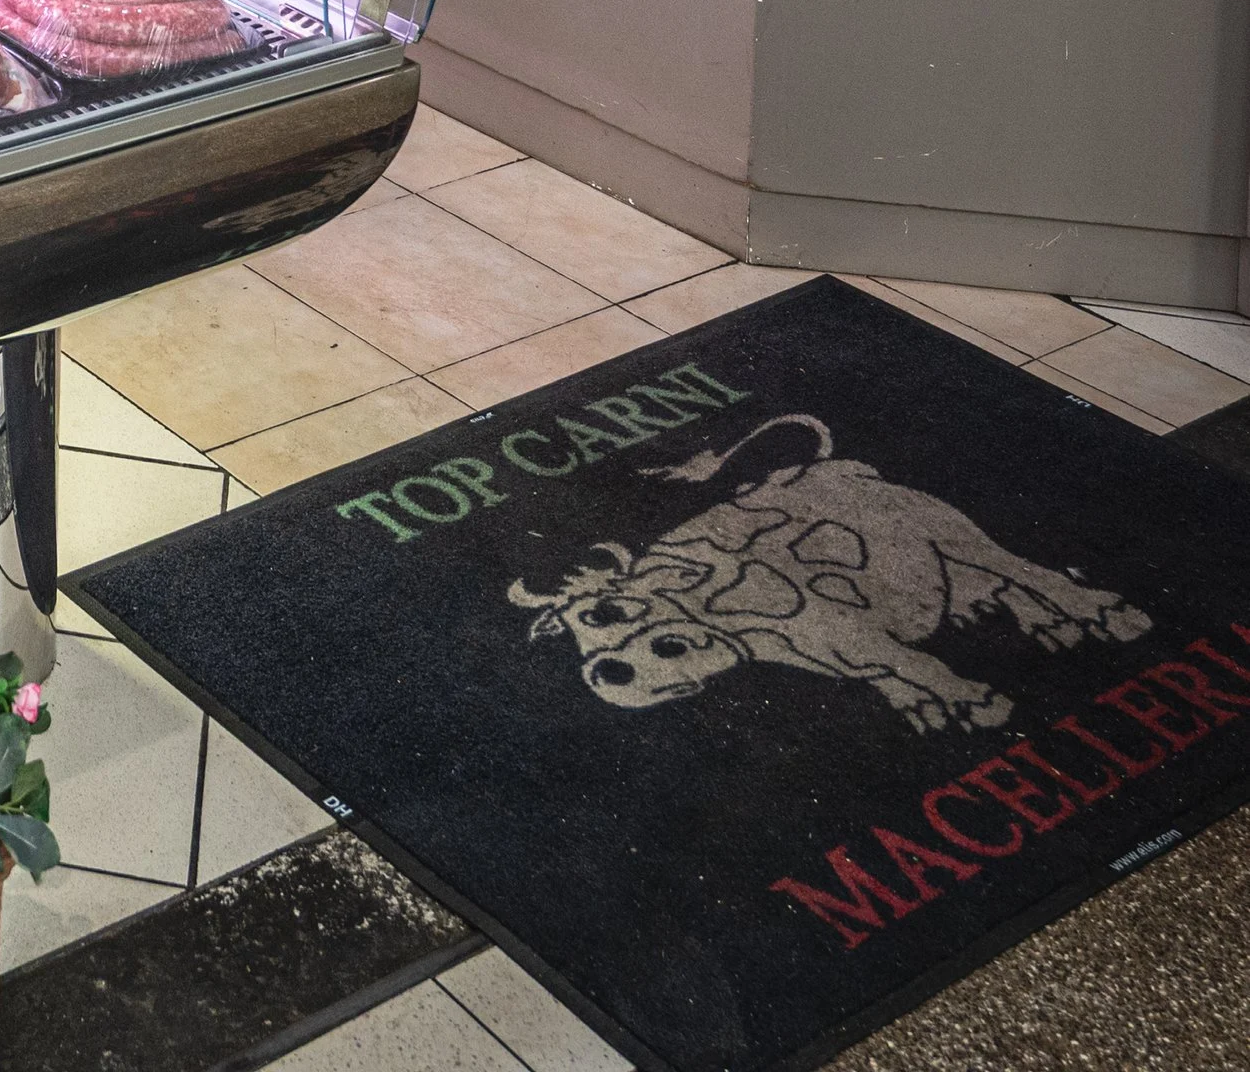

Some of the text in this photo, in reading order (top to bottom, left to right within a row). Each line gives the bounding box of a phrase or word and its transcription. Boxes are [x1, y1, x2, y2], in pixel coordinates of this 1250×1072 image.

[335, 361, 754, 544] TOP CARNI
[769, 622, 1250, 951] MACELLERI
[1109, 827, 1183, 874] www.elis.com
